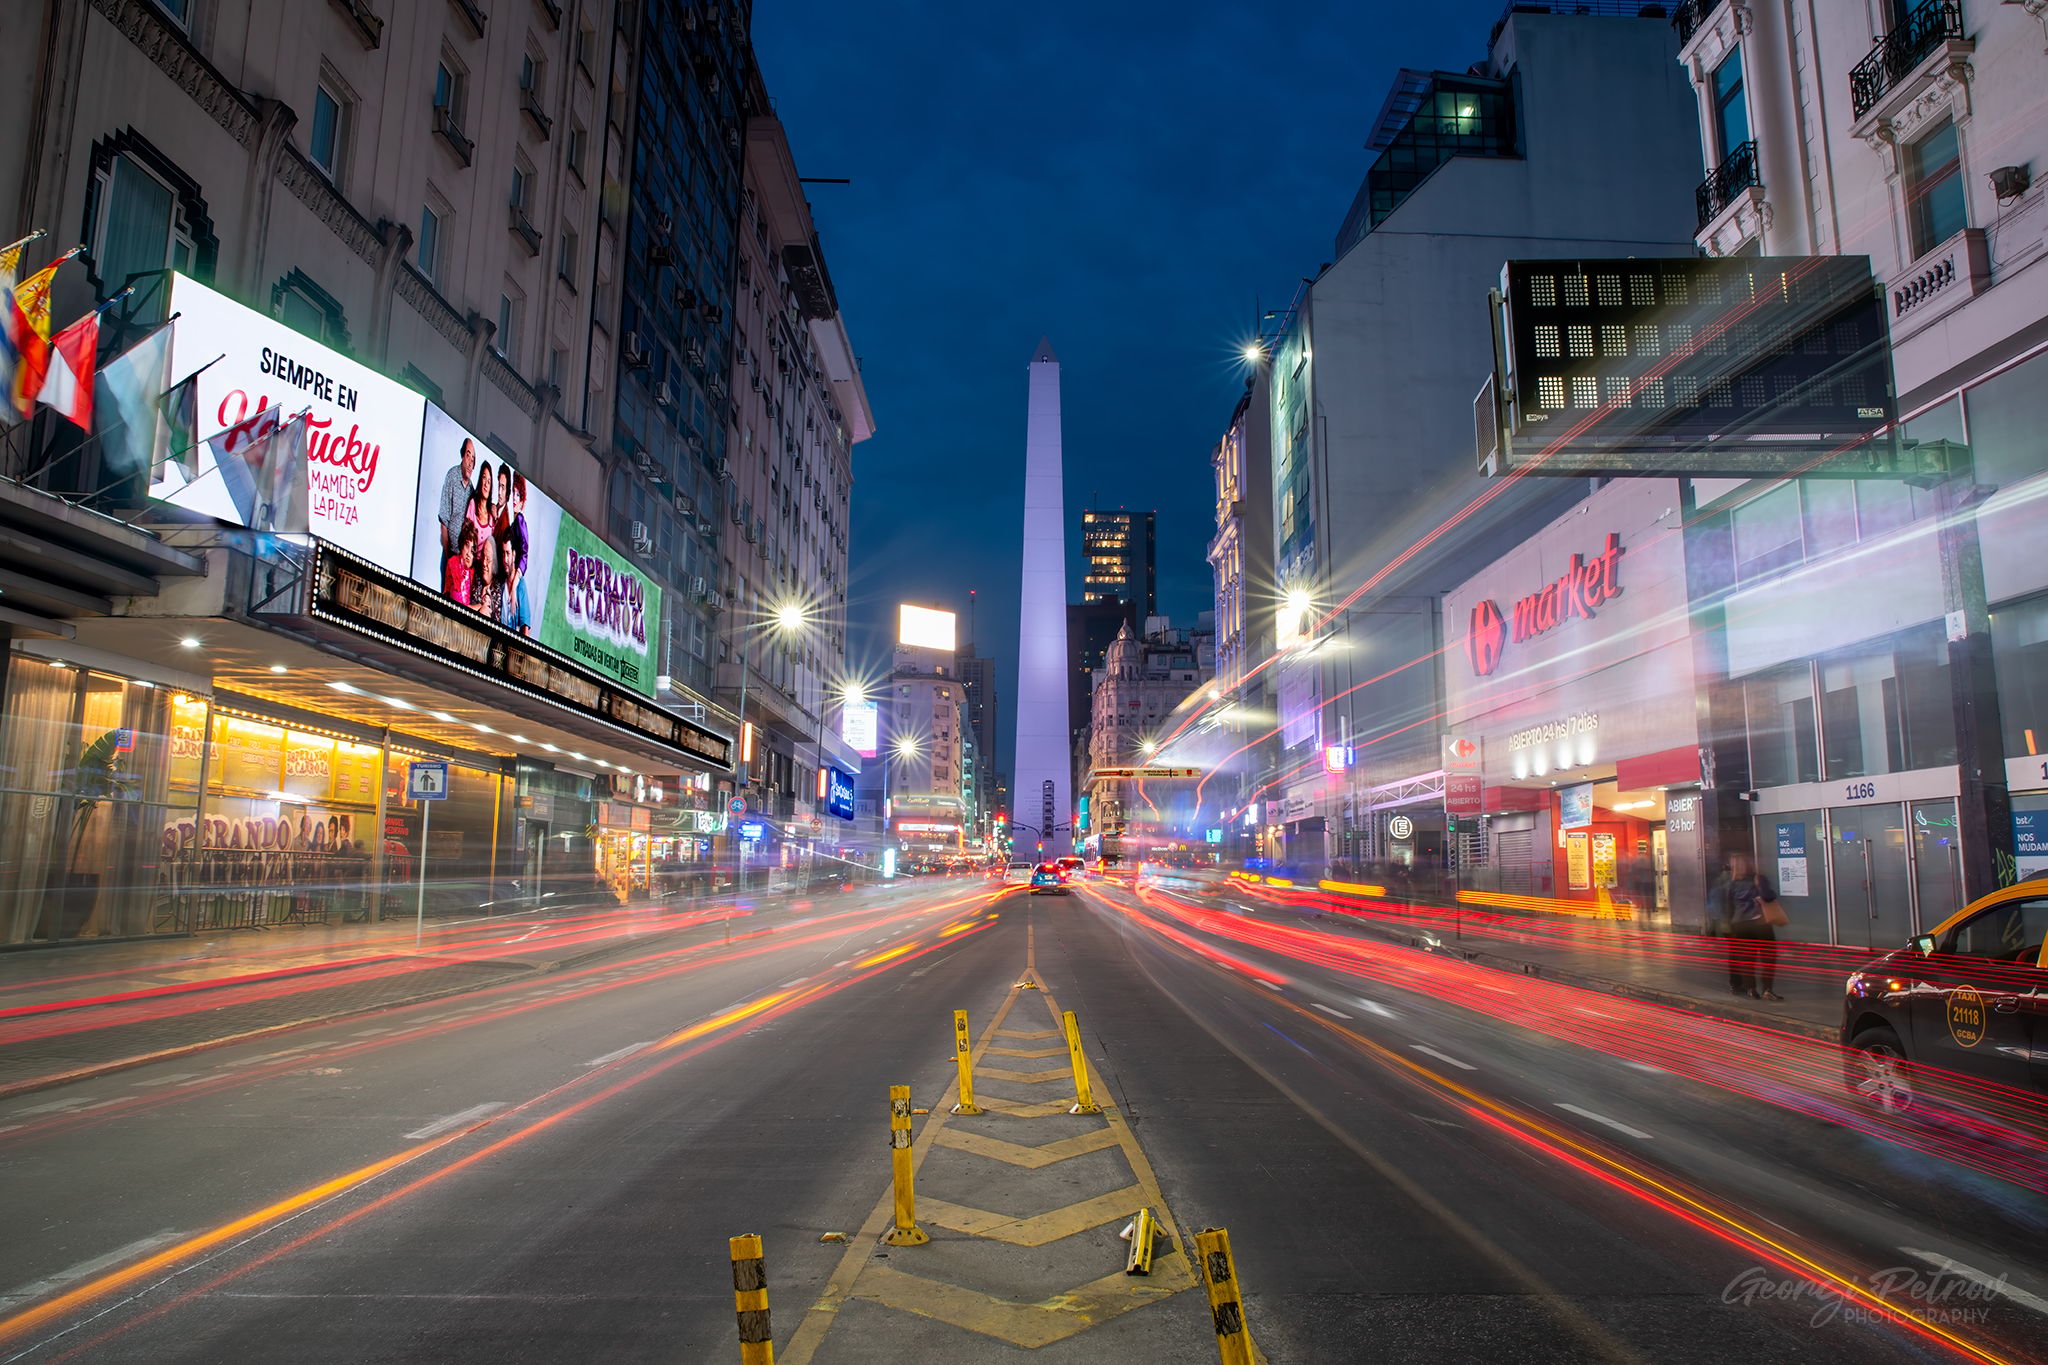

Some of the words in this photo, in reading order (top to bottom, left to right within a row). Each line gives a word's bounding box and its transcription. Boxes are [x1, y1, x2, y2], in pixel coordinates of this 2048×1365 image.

[260, 346, 334, 402] SIEMPRE
[337, 383, 358, 412] EN
[307, 469, 356, 500] MAMOS
[568, 547, 645, 613] ESPERANDO
[1512, 532, 1622, 643] market
[585, 588, 646, 646] CARROZA
[1508, 726, 1543, 752] ABIERTO
[1543, 722, 1555, 743] 24
[1570, 716, 1577, 735] 7
[1577, 711, 1599, 733] días
[1450, 783, 1464, 793] 24
[1464, 783, 1477, 793] hs
[1846, 782, 1875, 800] 1166
[1446, 797, 1481, 805] ABIERTO
[1667, 796, 1703, 813] ABIER
[1669, 820, 1681, 833] 24
[2017, 832, 2035, 842] NOS
[1779, 847, 1804, 855] MUDAMOS
[1957, 991, 1977, 1002] TAXI
[1953, 1006, 1979, 1025] 21118
[1957, 1029, 1977, 1041] GCBA
